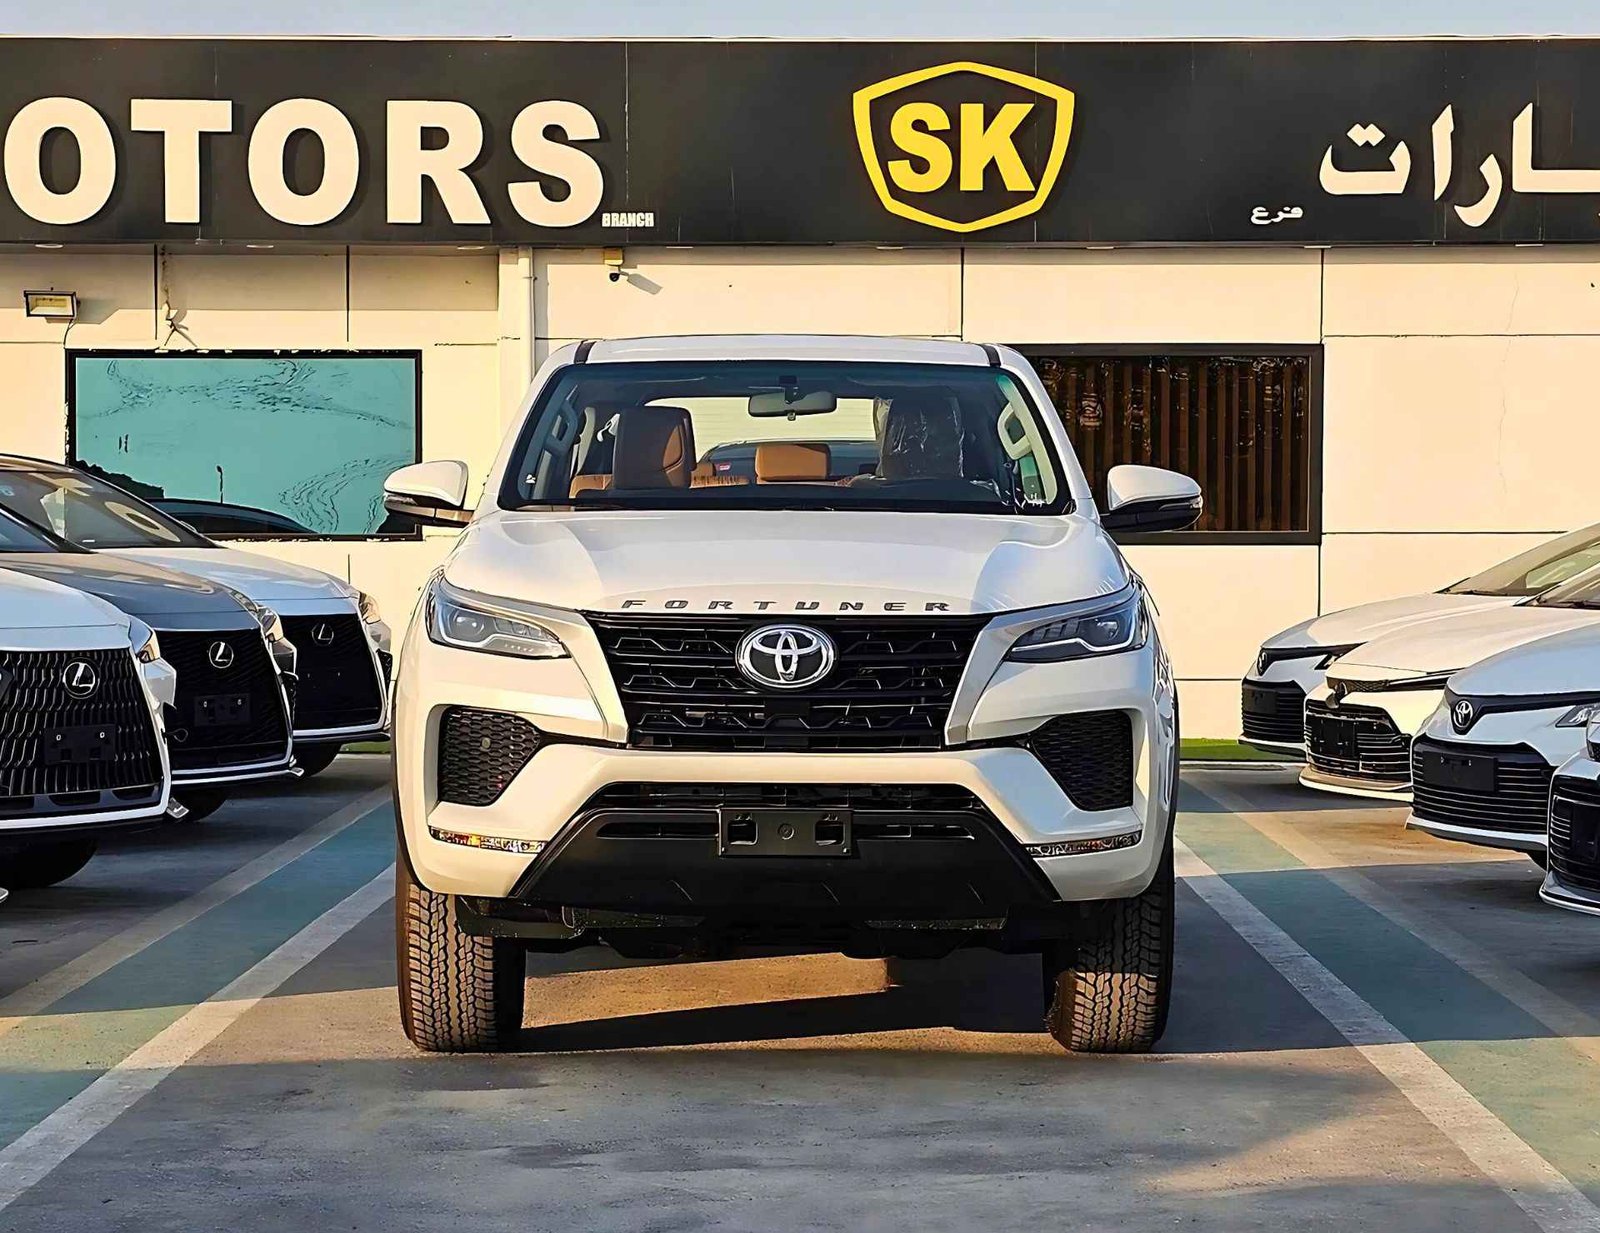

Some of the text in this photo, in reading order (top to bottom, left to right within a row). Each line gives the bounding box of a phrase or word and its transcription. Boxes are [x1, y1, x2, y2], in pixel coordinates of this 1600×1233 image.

[3, 96, 605, 228] OTORS
[887, 101, 1036, 193] SK
[1319, 102, 1600, 228] ارات
[601, 212, 655, 228] BRANCH
[1250, 206, 1304, 225] فرع
[621, 599, 951, 612] FORTUNER
